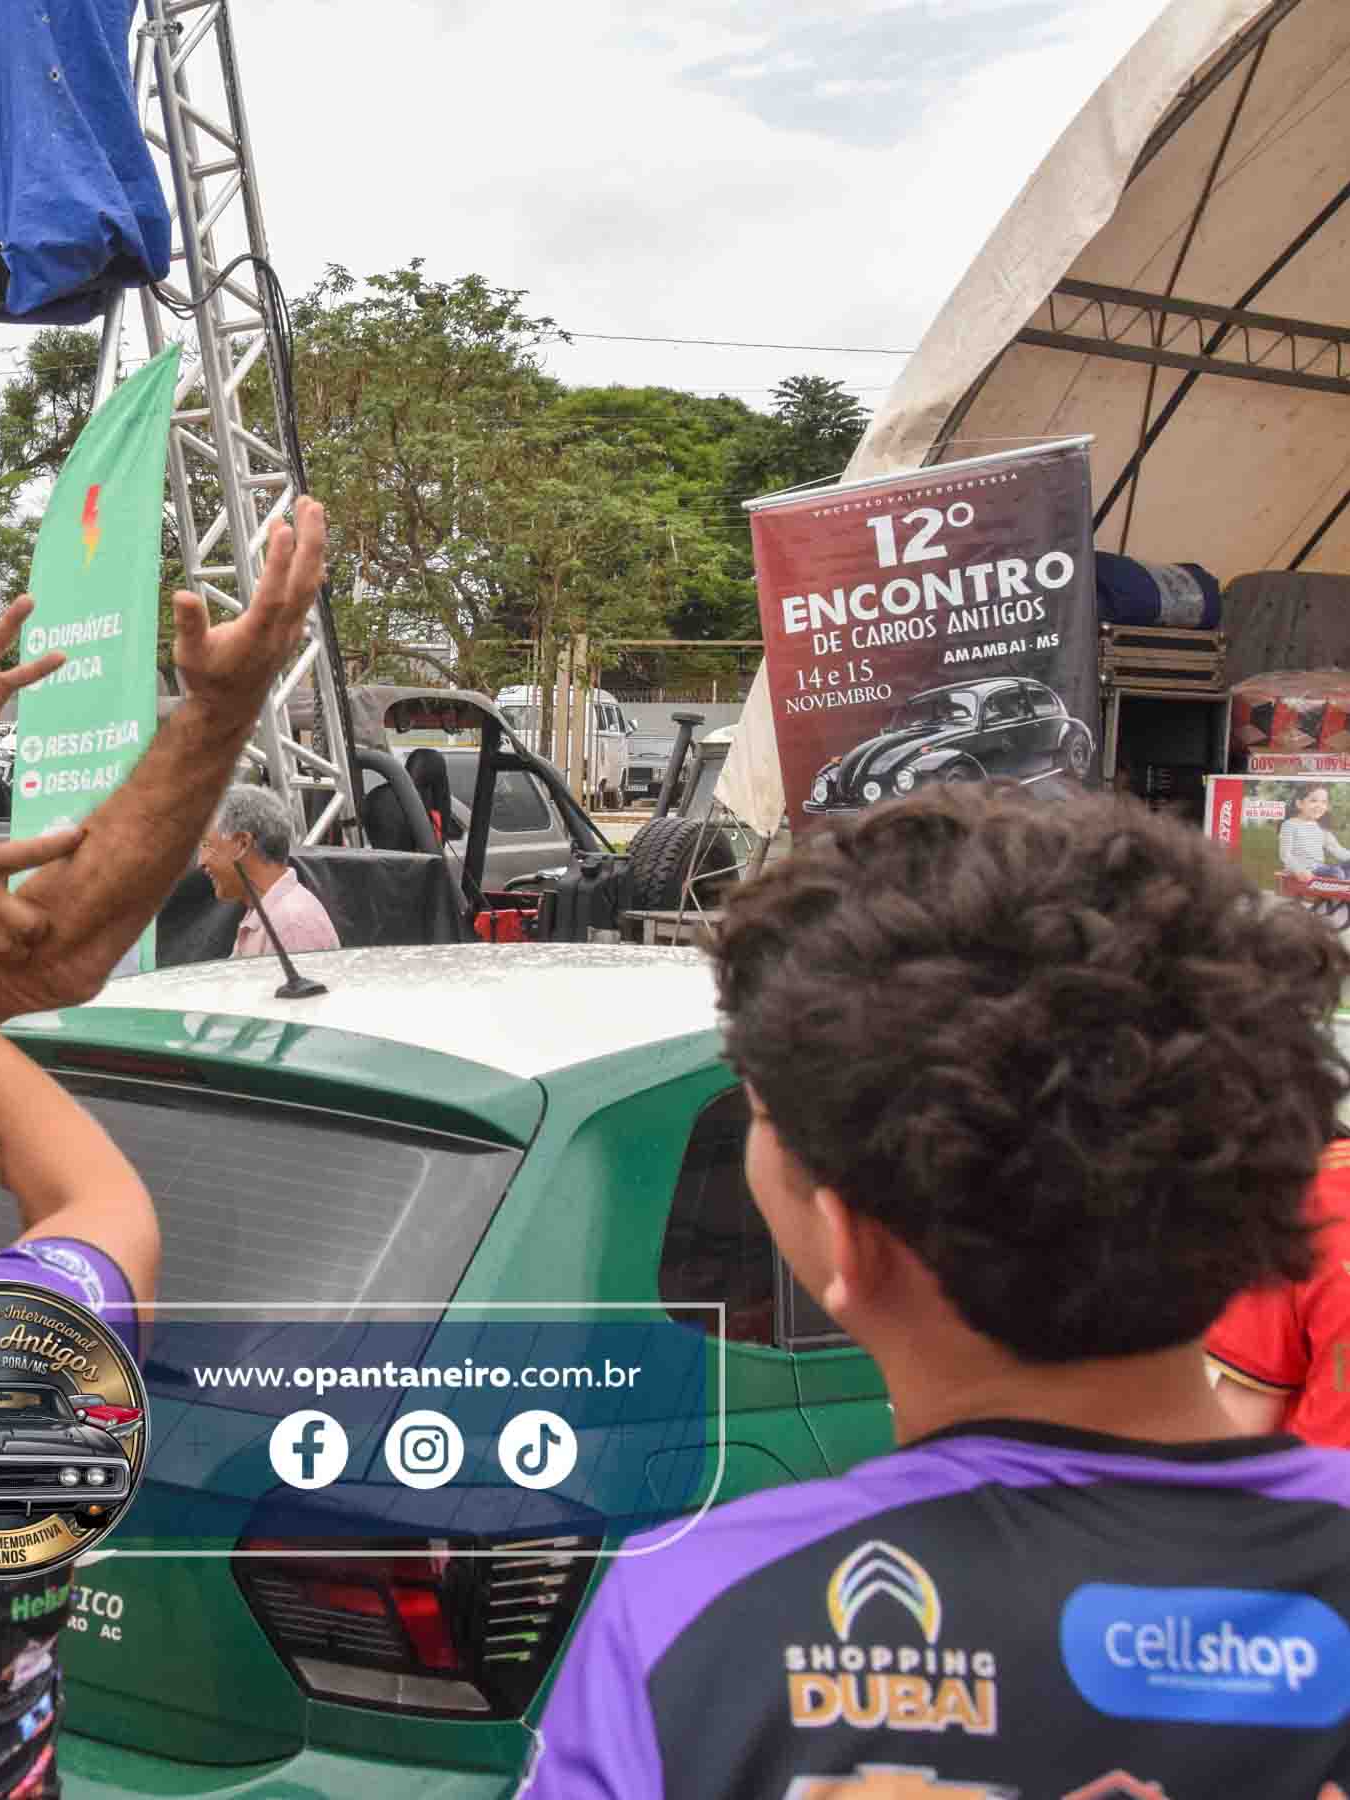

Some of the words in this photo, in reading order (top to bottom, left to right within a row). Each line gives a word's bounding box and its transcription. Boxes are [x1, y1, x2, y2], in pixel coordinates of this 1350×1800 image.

[781, 551, 1075, 635] ENCONTRO
[813, 633, 843, 656] DE
[852, 616, 937, 649] CARROS
[947, 596, 1045, 635] ANTIGOS
[943, 639, 1027, 665] AMAMBAI
[1036, 633, 1060, 648] MS
[797, 668, 823, 691] 14
[827, 670, 839, 687] e
[848, 658, 875, 683] 15
[785, 683, 892, 714] NOVEMBRO
[74, 1586, 124, 1619] ICO
[99, 1623, 123, 1641] AC
[784, 1644, 996, 1678] SHOPPING
[1105, 1616, 1318, 1691] cellshop
[787, 1671, 998, 1734] DUBAI
